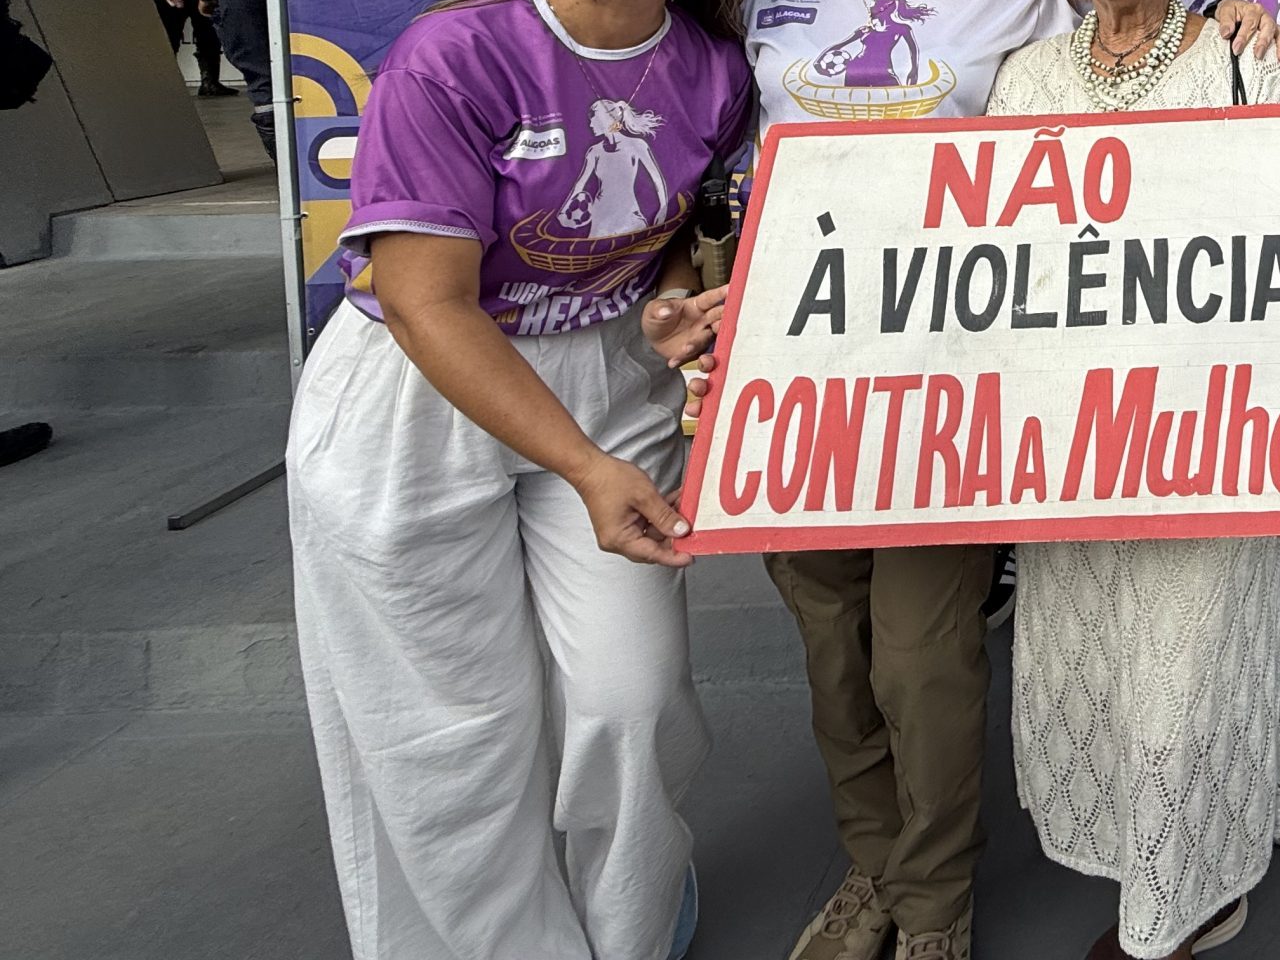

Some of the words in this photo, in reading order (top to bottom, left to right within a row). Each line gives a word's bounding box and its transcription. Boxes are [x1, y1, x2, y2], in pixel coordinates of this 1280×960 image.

[923, 126, 1132, 229] NÃO
[786, 211, 846, 336] À
[718, 372, 1002, 516] CONTRA
[1010, 416, 1047, 506] A
